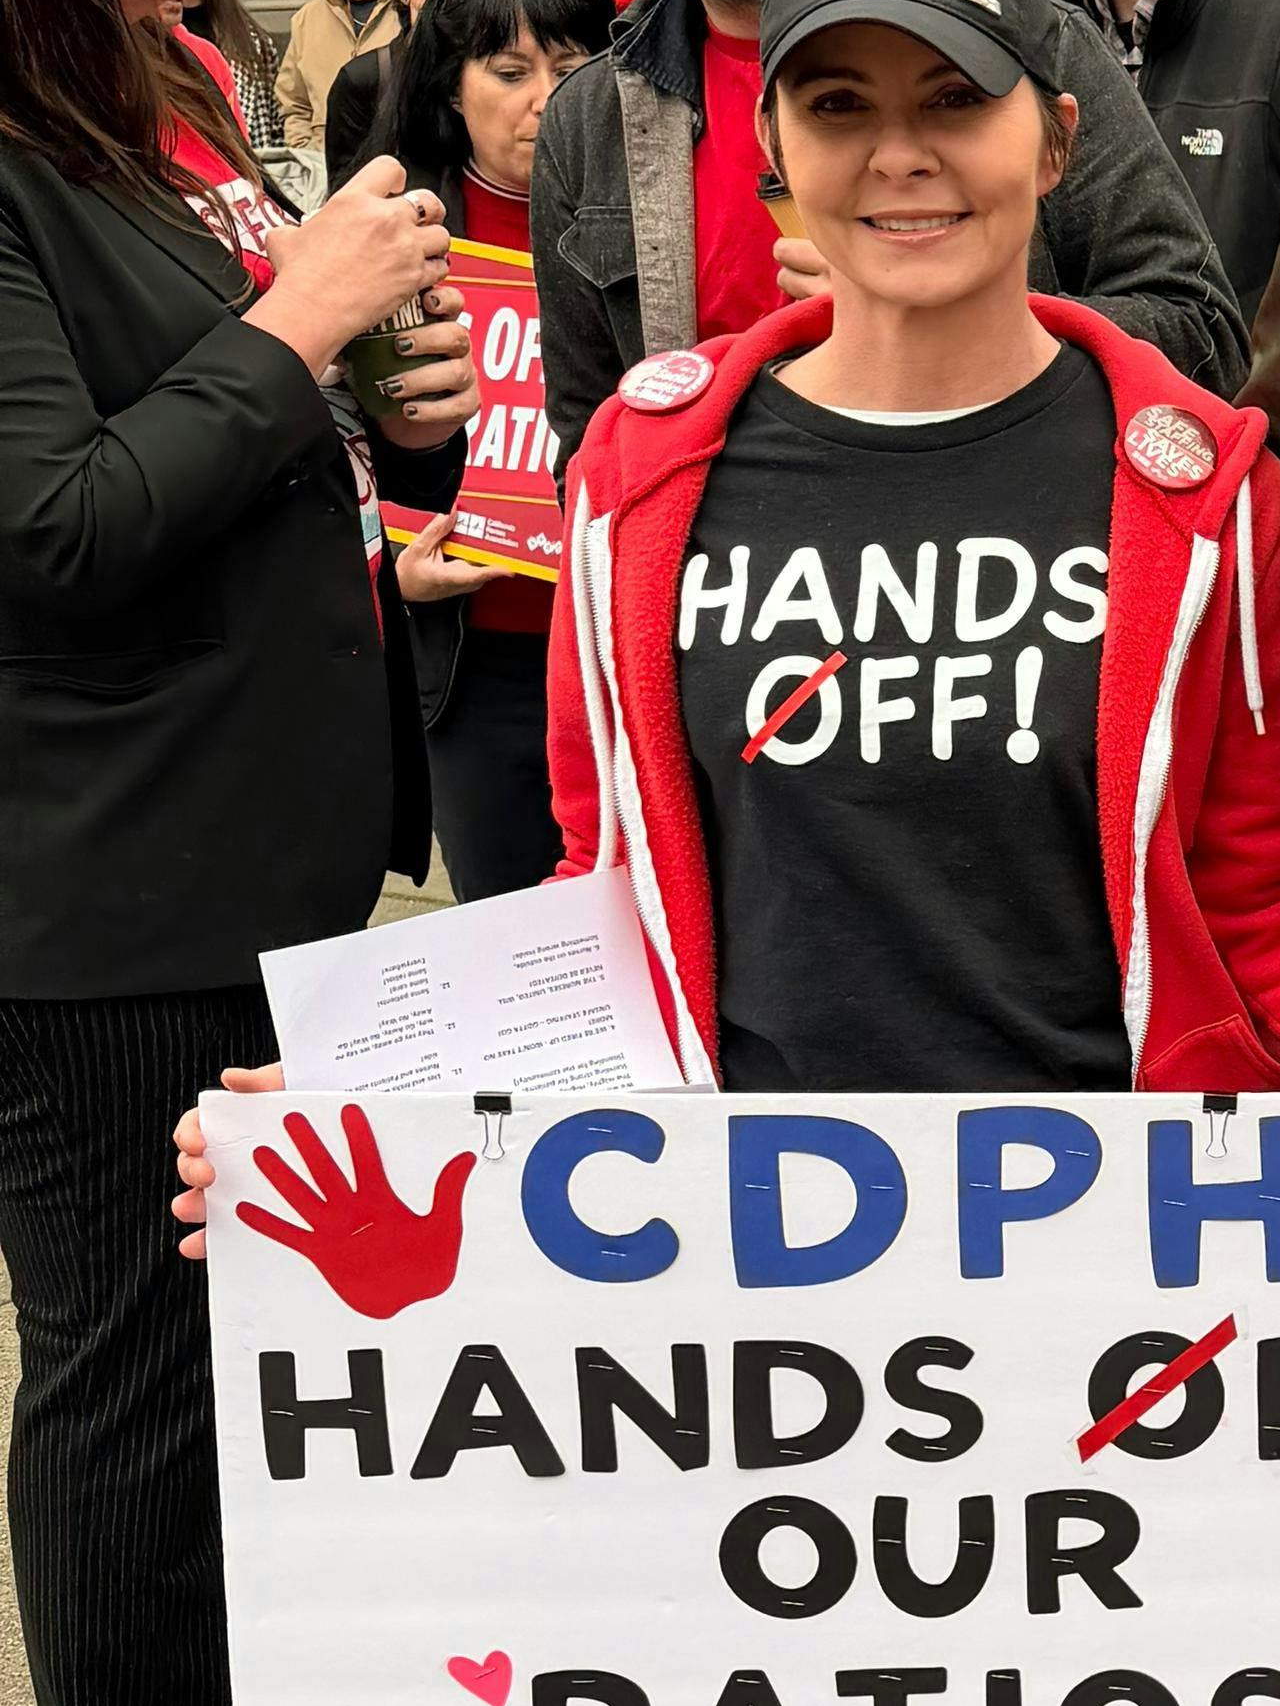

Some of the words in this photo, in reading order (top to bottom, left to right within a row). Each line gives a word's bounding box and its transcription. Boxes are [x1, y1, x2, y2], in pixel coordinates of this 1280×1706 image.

[482, 306, 545, 385] OF
[1126, 431, 1181, 478] LIVES
[1143, 415, 1215, 463] STAFFING
[1145, 407, 1200, 441] SAFE
[1146, 428, 1204, 481] SAVES
[679, 537, 1109, 651] HANDS
[744, 646, 1044, 766] OFF!
[258, 1335, 985, 1480] HANDS
[718, 1489, 1143, 1620] OUR
